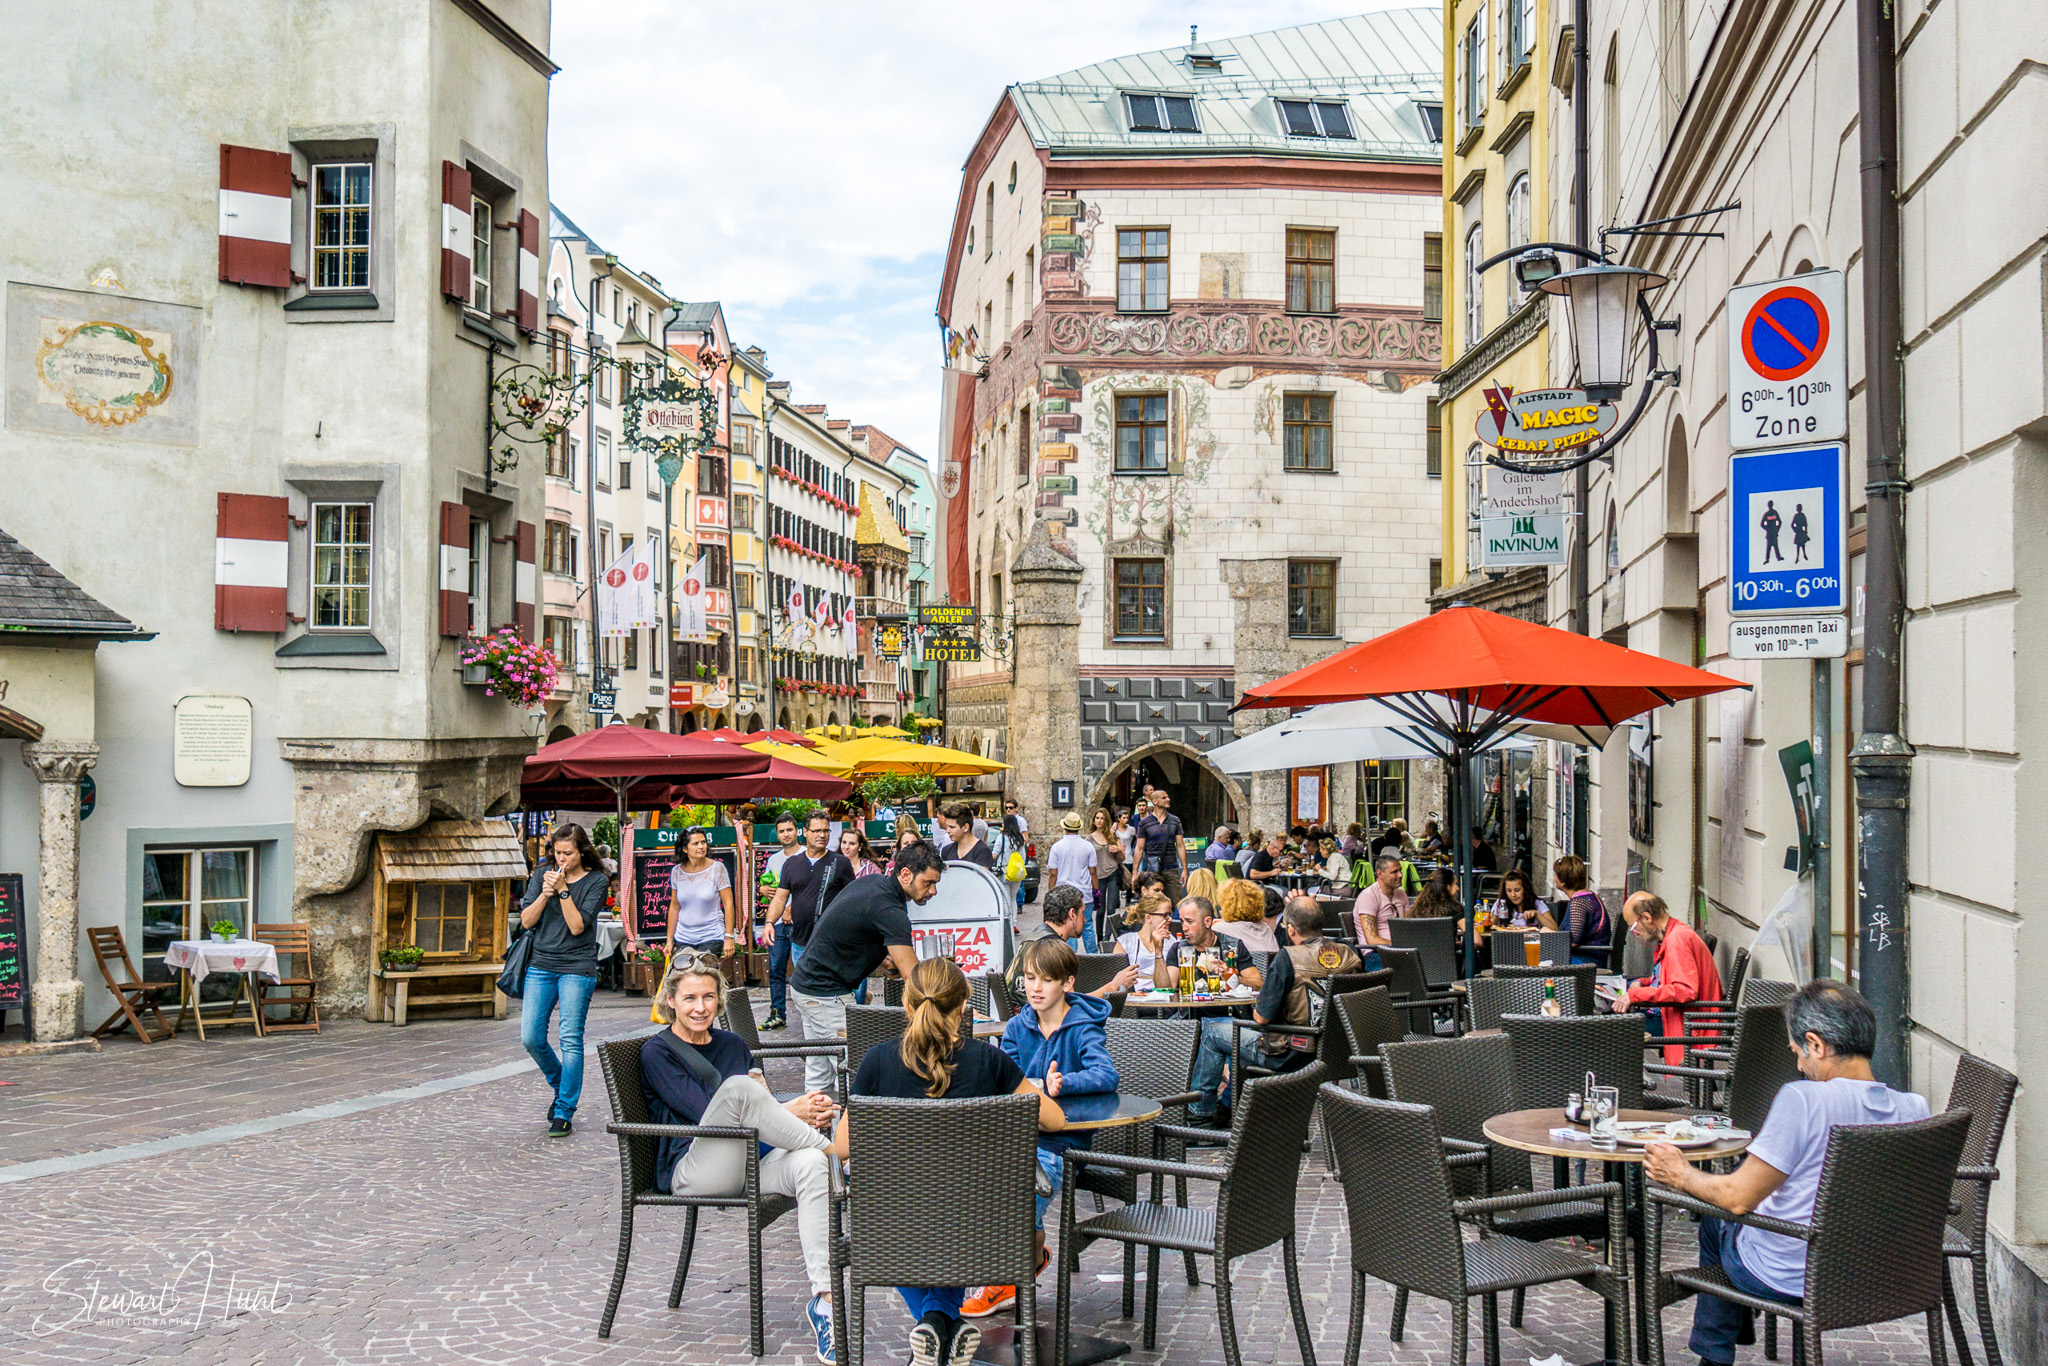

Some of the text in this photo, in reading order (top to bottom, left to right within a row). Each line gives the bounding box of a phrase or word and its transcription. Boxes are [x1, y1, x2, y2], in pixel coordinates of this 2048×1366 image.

[1518, 392, 1573, 405] ALTSTADT
[647, 408, 693, 427] Ottoburg
[1521, 405, 1598, 430] MAGIC
[1755, 416, 1817, 438] Zone
[1495, 427, 1600, 451] KEBAP PIZZA
[1502, 472, 1546, 484] Galerie
[1517, 484, 1532, 494] im
[1489, 493, 1561, 508] Andechshof
[1489, 537, 1559, 553] INVINUM
[922, 608, 972, 616] GOLDENER
[1736, 620, 1838, 638] ausgenommen Taxi
[1755, 642, 1773, 652] von
[924, 648, 980, 661] HOTEL
[592, 693, 613, 704] Piano
[955, 954, 981, 967] 2,90
